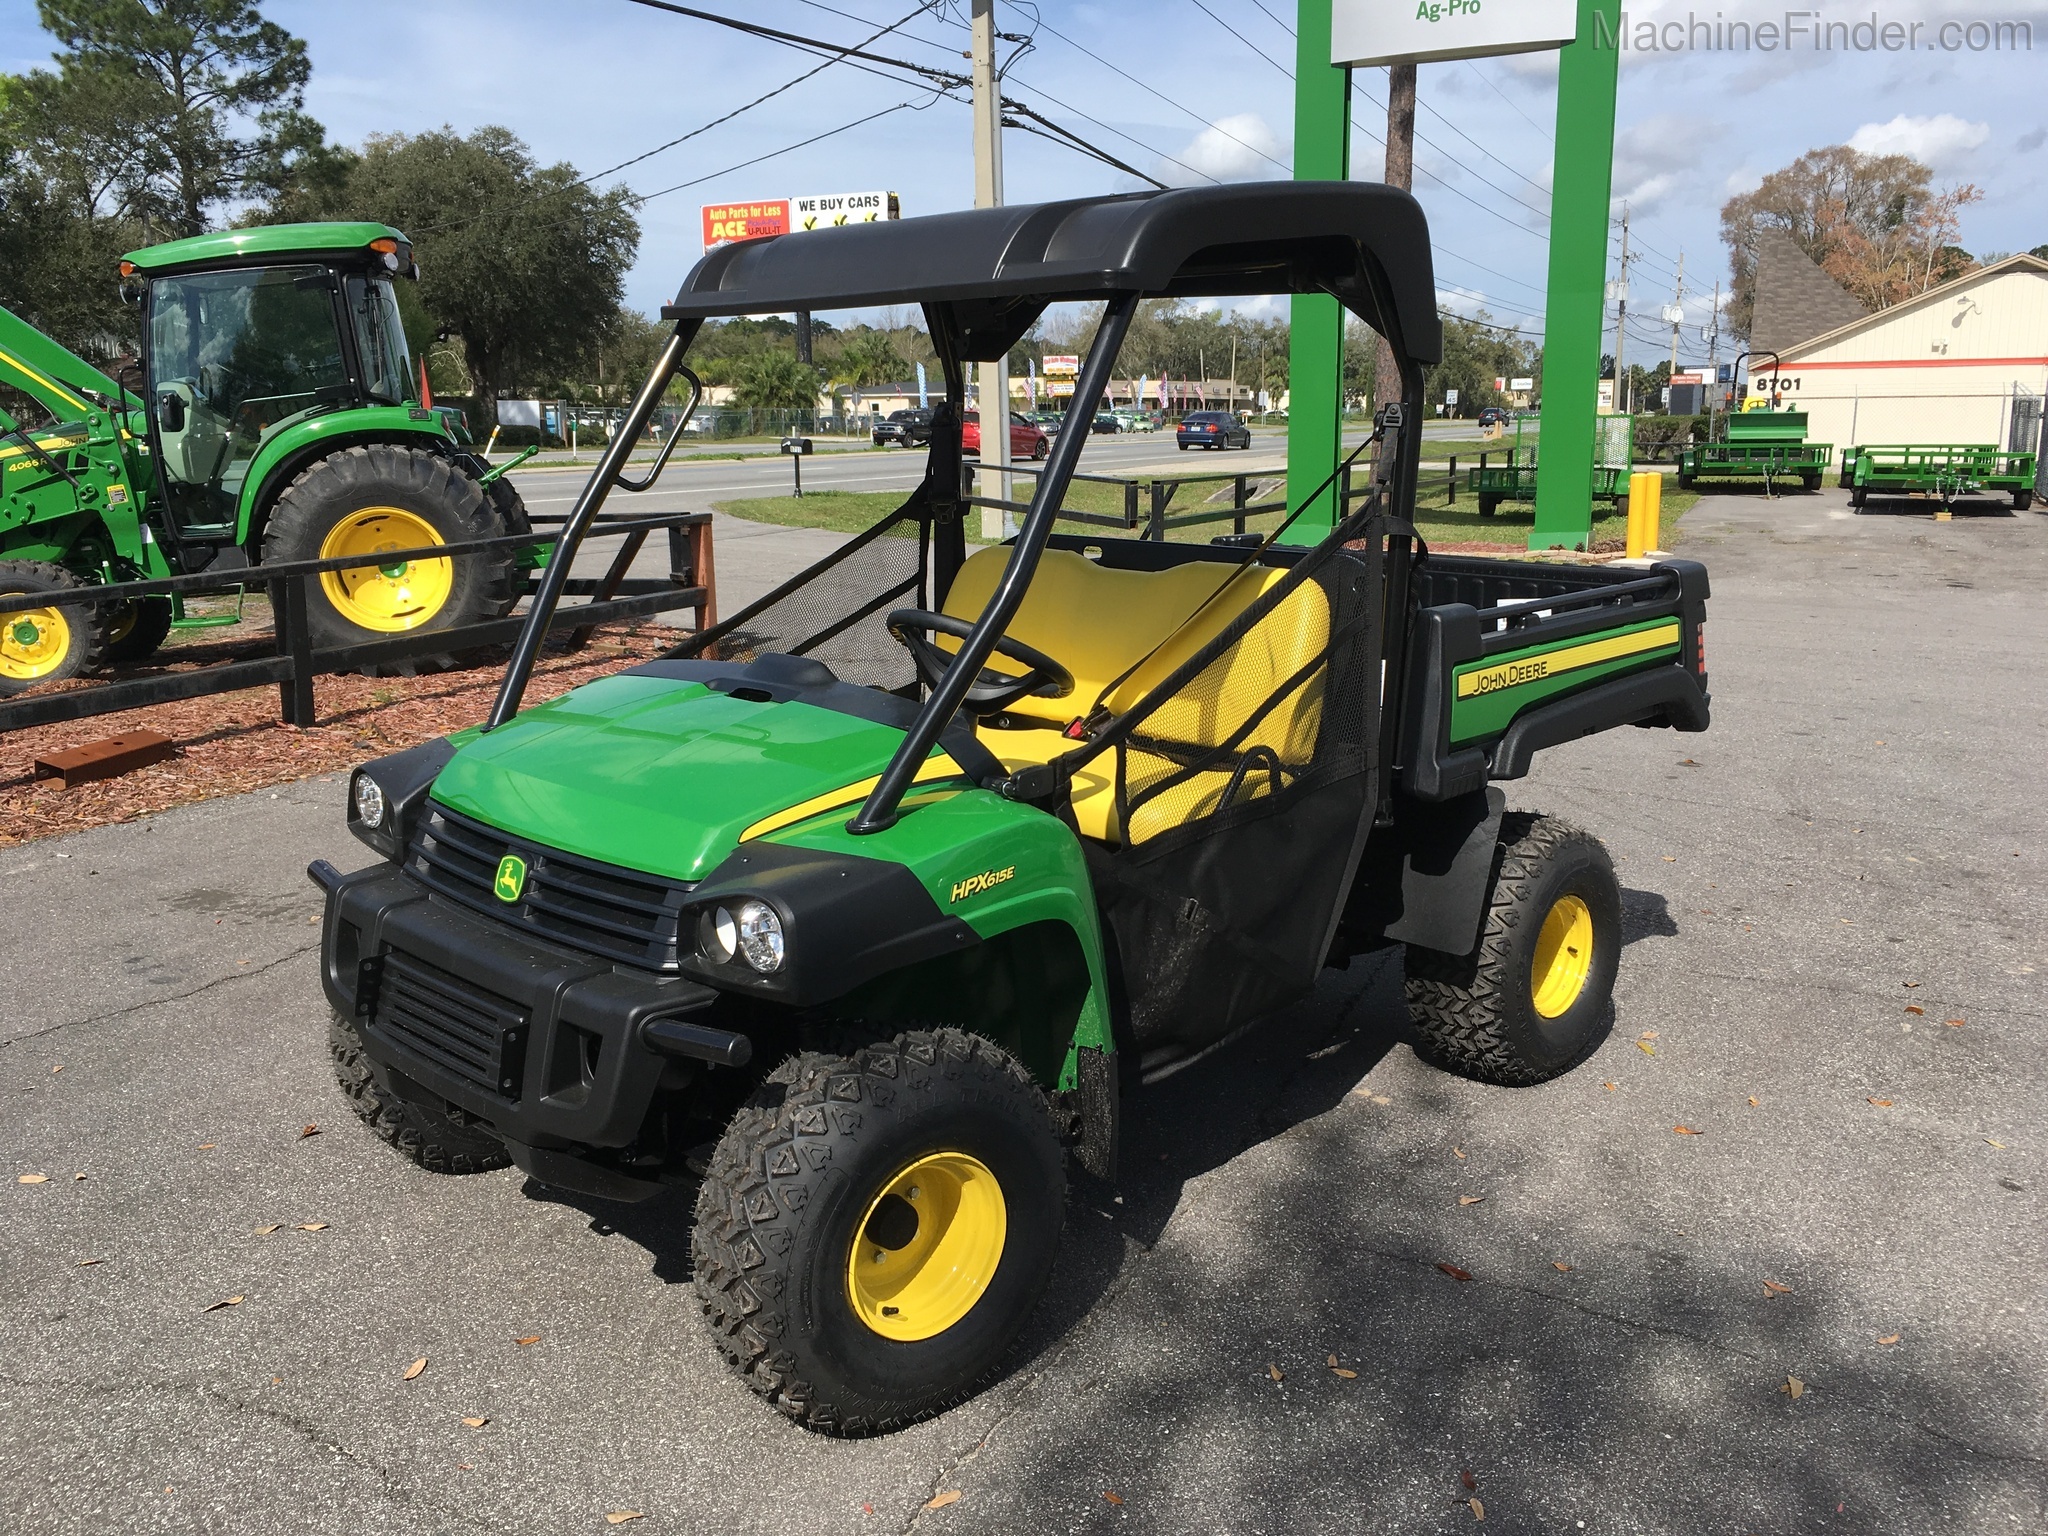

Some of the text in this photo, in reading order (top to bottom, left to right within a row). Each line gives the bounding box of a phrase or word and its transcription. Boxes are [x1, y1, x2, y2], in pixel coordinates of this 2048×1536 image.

[1416, 0, 1481, 22] Ag-Pro
[799, 195, 880, 212] WE BUY CARS
[709, 205, 781, 221] Auto Parts for Less
[711, 220, 747, 238] ACE
[748, 226, 781, 236] U-PULL-IT
[1756, 377, 1801, 391] 8701
[58, 437, 86, 447] JOHN
[1473, 661, 1548, 693] JOHN DEERE
[950, 865, 1016, 904] HPX615E
